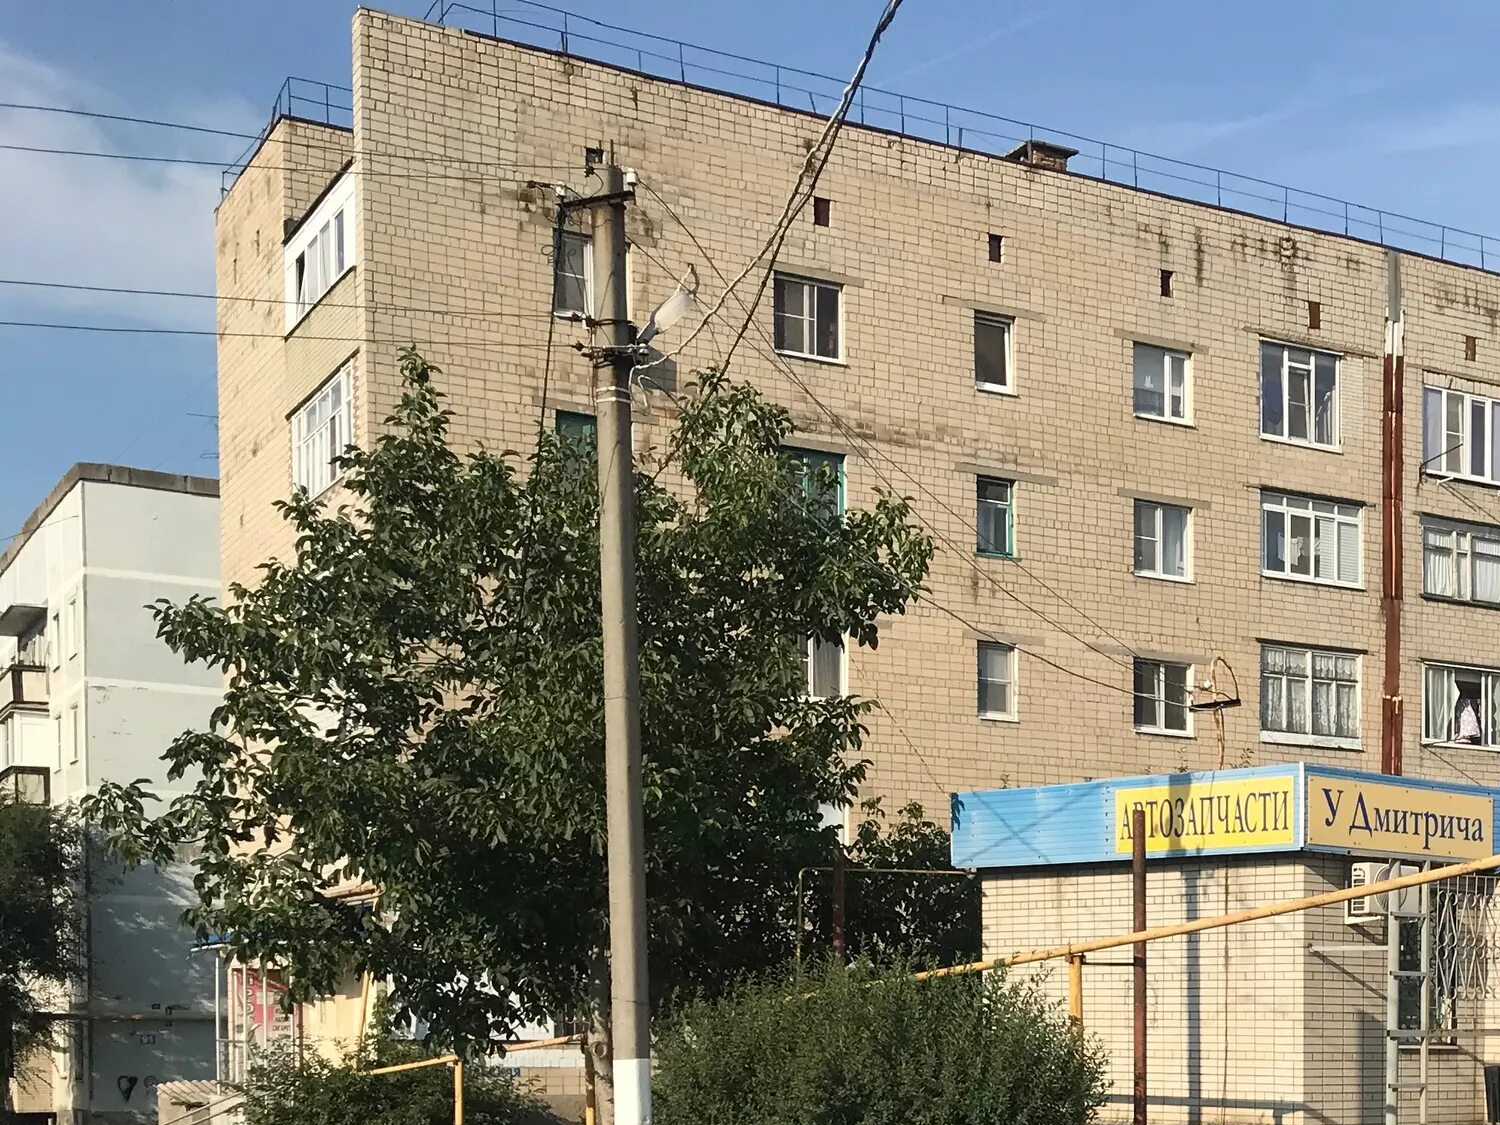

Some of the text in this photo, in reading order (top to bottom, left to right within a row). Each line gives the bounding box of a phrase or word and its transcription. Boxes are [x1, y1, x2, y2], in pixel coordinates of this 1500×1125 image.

[1120, 790, 1289, 840] АТОЗАПЧАСТИ
[1322, 787, 1484, 850] У Дмитрича
